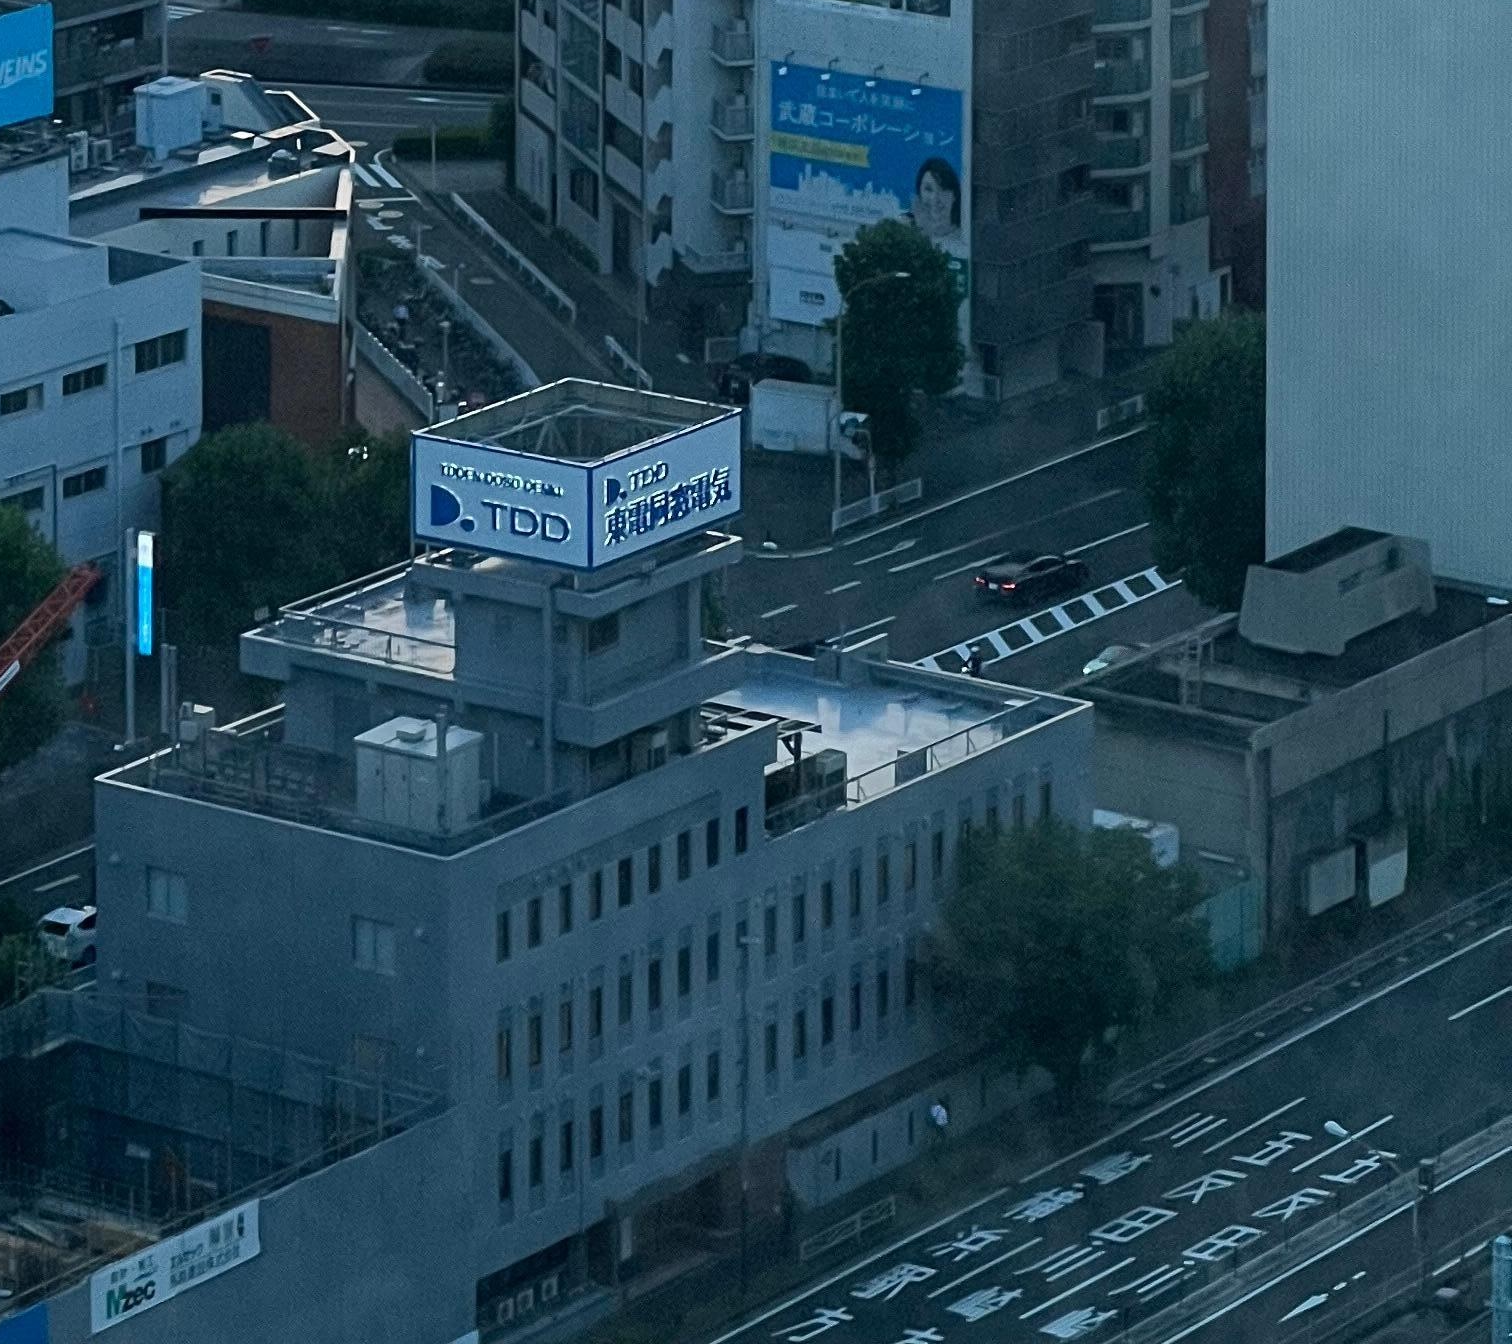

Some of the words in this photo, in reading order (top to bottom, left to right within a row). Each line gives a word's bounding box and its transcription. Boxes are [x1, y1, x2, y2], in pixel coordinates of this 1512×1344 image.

[778, 99, 954, 147] 武蔵コーポレーション
[627, 460, 668, 492] TDD
[481, 499, 571, 544] TDD
